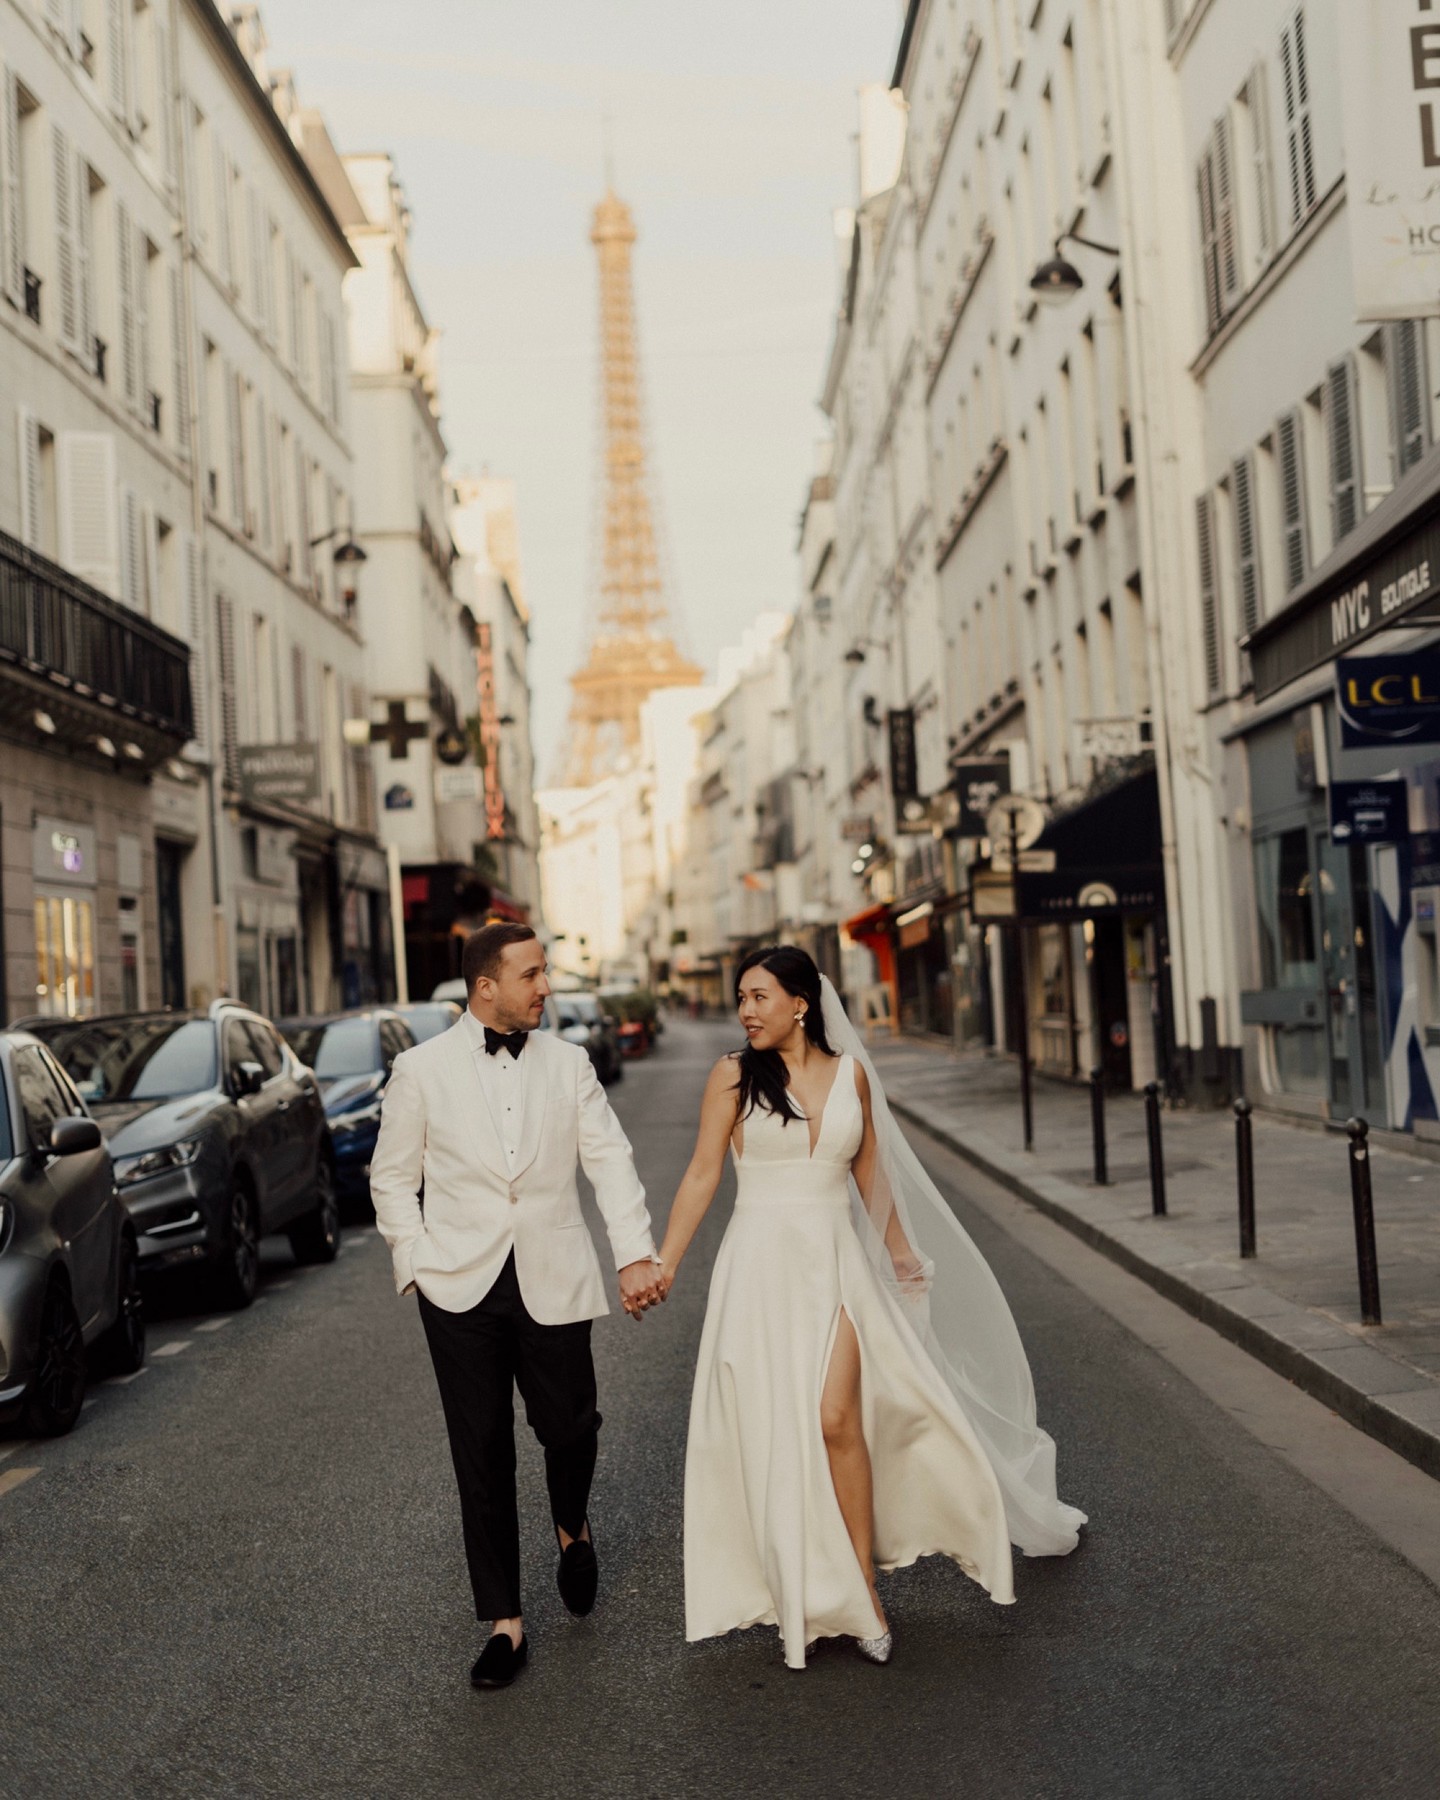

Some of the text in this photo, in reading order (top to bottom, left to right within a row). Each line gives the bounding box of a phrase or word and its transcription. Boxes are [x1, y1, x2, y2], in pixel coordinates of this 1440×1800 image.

[1331, 560, 1431, 645] MYC BOUTIQUE
[1347, 673, 1439, 706] LCL
